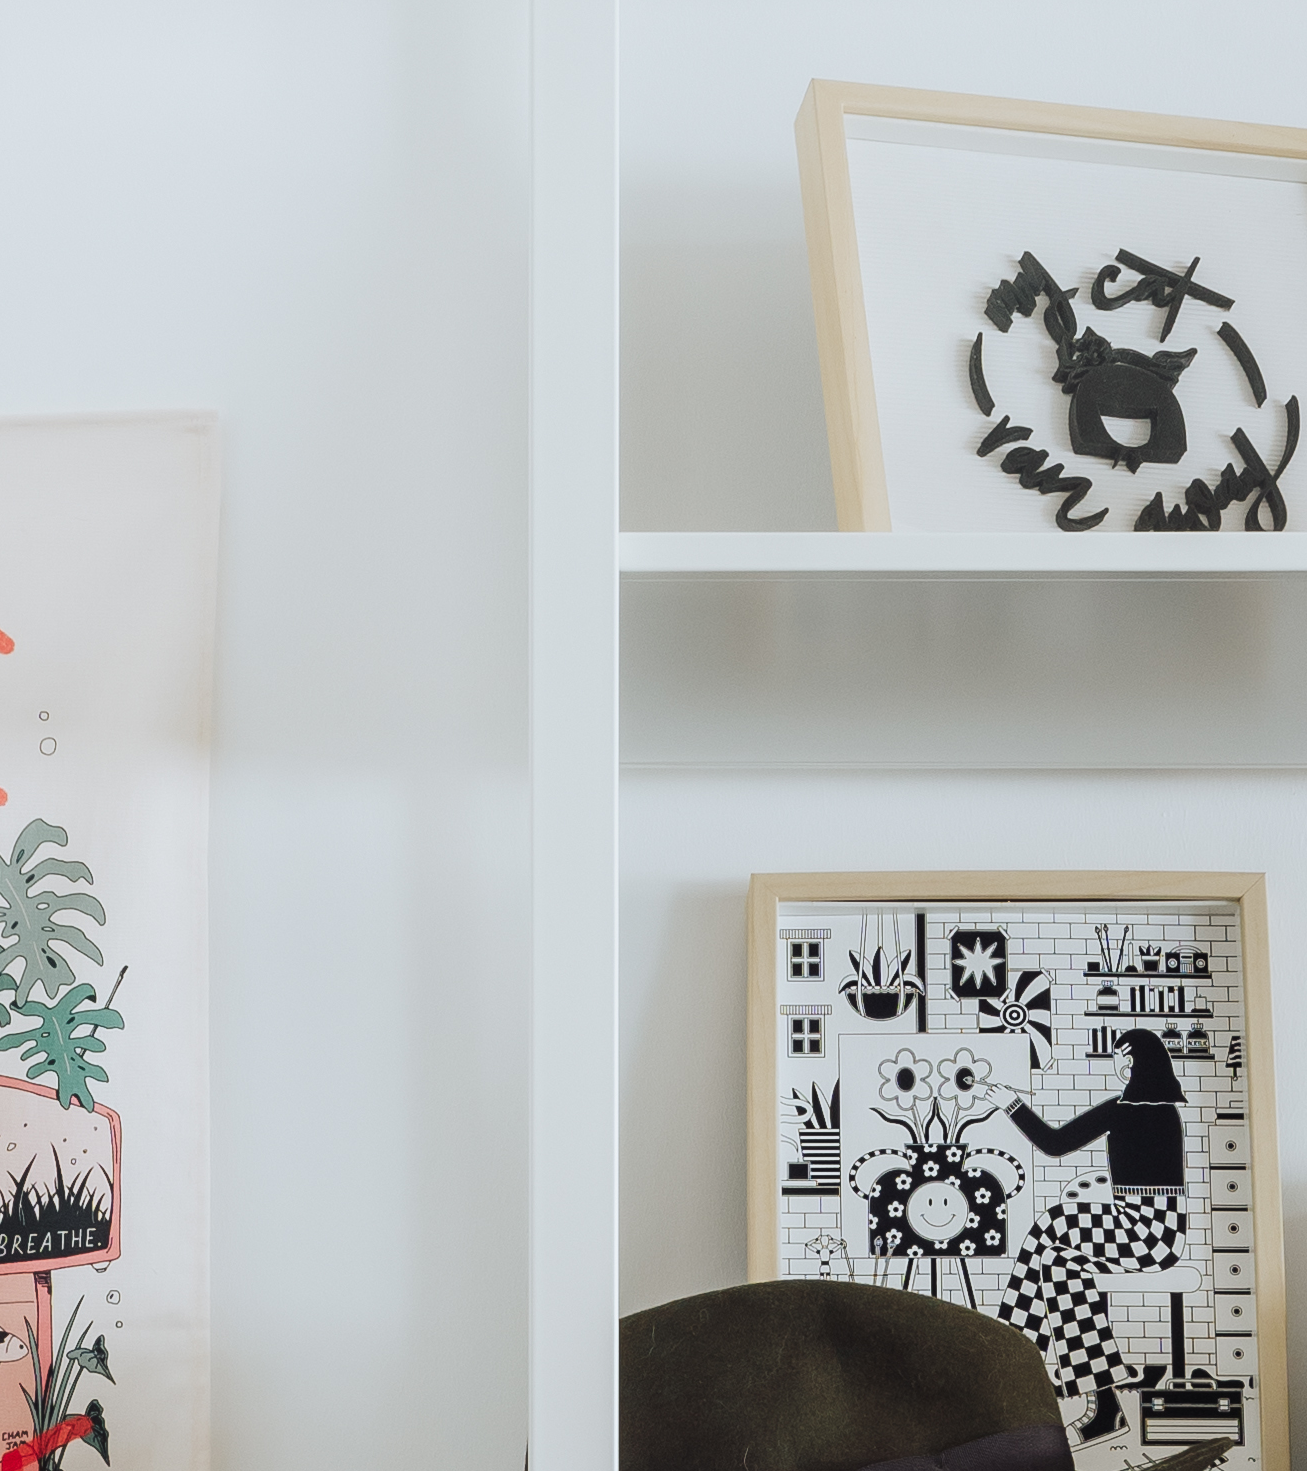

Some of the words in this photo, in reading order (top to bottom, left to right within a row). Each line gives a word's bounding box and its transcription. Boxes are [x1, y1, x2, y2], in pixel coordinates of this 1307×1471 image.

[984, 251, 1079, 347] my
[1091, 248, 1235, 343] cat
[976, 414, 1109, 531] ran
[1134, 394, 1300, 531] away
[1, 1429, 30, 1442] CHAM
